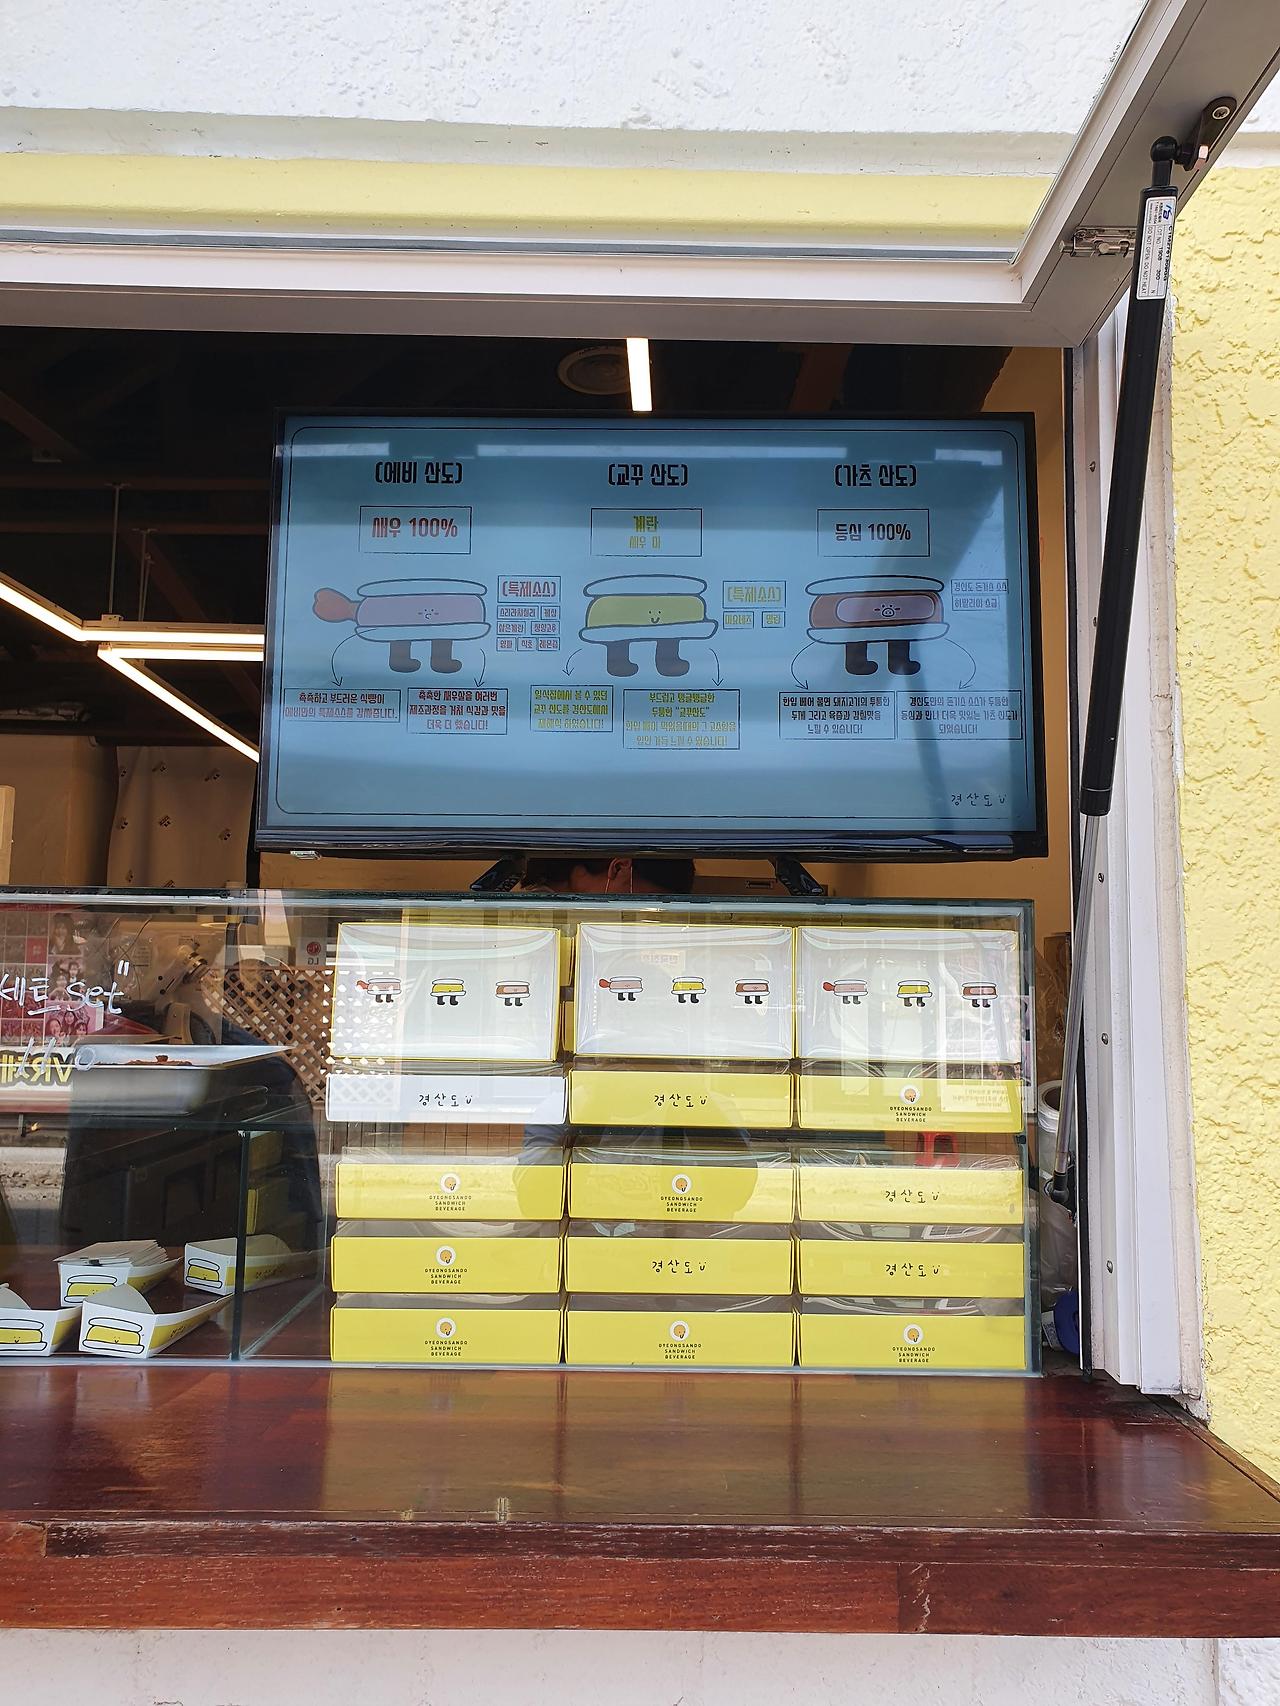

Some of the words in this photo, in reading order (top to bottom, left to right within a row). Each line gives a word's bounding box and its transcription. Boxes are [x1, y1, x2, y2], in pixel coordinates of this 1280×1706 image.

[1143, 262, 1150, 270] DO
[372, 517, 401, 538] 새우
[408, 517, 458, 538] 100%
[633, 515, 659, 533] 계란
[835, 523, 862, 541] 등심
[868, 523, 911, 541] 100%
[299, 692, 328, 703] 촉촉하고
[330, 693, 358, 703] 부드러운
[360, 693, 385, 704] 식빵이
[419, 690, 441, 701] 촉촉한
[444, 690, 473, 701] 새우살을
[475, 691, 497, 702] 여러번
[584, 690, 590, 701] 수
[783, 696, 797, 707] 한입
[800, 696, 814, 707] 베어
[817, 696, 831, 707] 물면
[833, 696, 867, 707] 돼지고기의
[409, 704, 446, 716] 제조과정을
[466, 705, 488, 716] 식감과
[491, 705, 505, 716] 맛을
[572, 704, 608, 715] 경산도에서
[791, 710, 806, 721] 두께
[808, 710, 826, 721] 그리고
[829, 710, 850, 721] 육즙과
[853, 710, 881, 721] 감칠맛을
[824, 724, 830, 734] 수
[832, 723, 863, 734] 있습니다!
[951, 793, 993, 807] 경산도
[418, 1093, 459, 1107] 경산도
[654, 1093, 694, 1108] 경산도
[885, 1189, 927, 1204] 경산도
[652, 1260, 693, 1274] 경산도
[885, 1262, 927, 1277] 경산도
